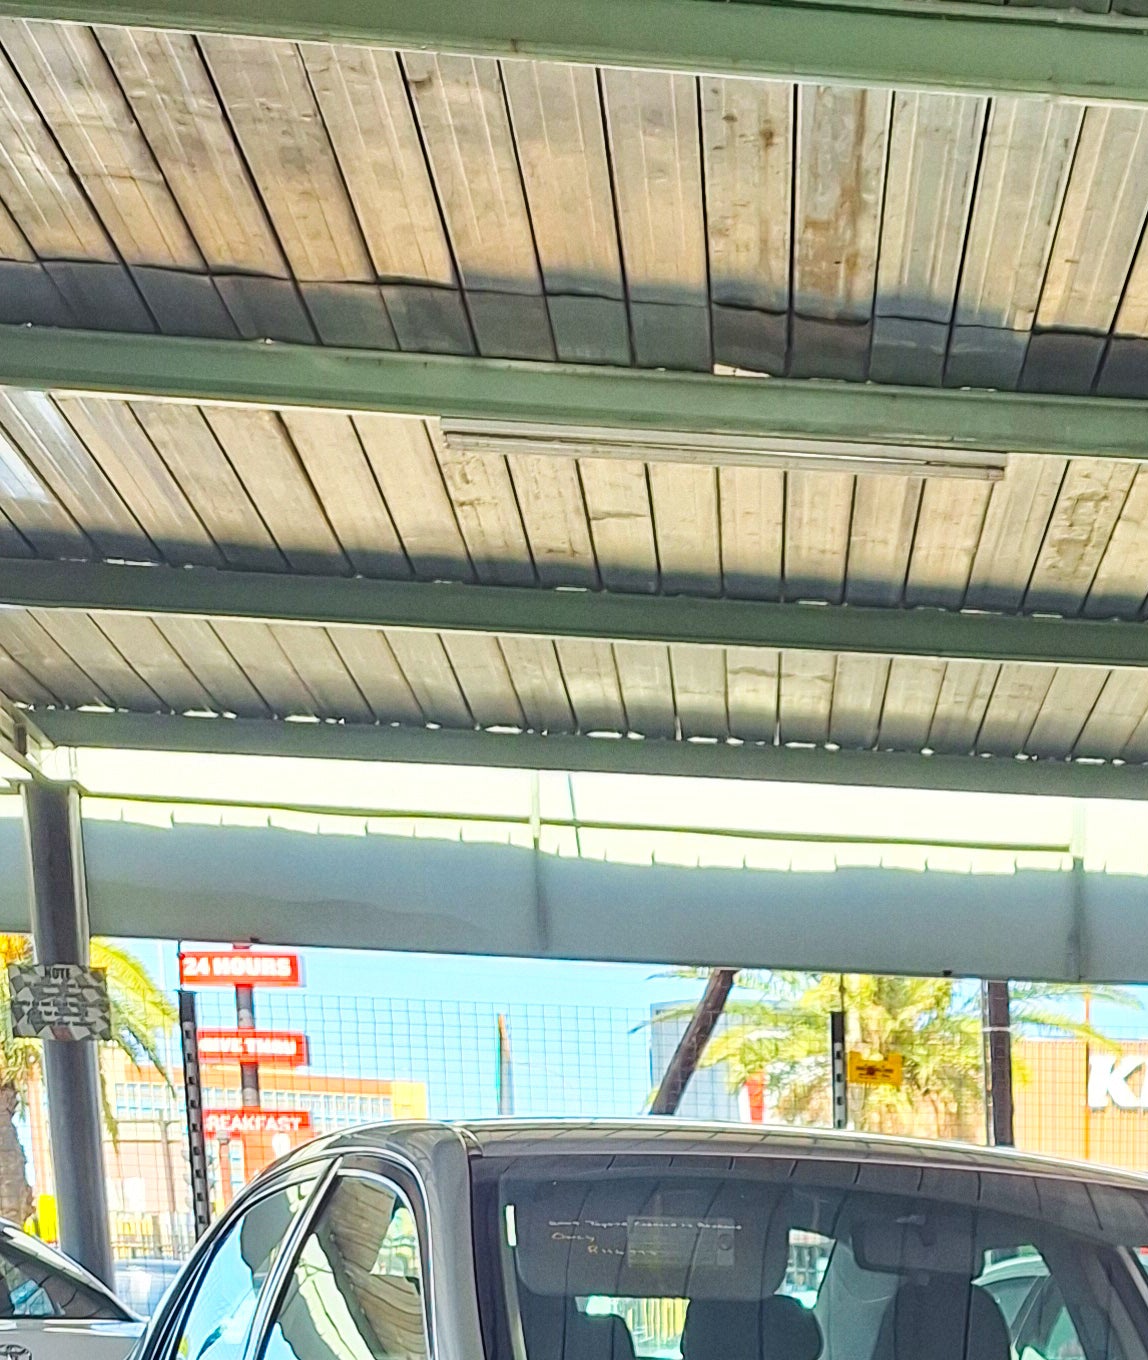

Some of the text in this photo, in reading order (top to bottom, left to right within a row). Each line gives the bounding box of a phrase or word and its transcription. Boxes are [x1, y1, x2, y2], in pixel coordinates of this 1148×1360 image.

[182, 957, 291, 977] 24 HOURS
[204, 1113, 302, 1132] REAKFAST
